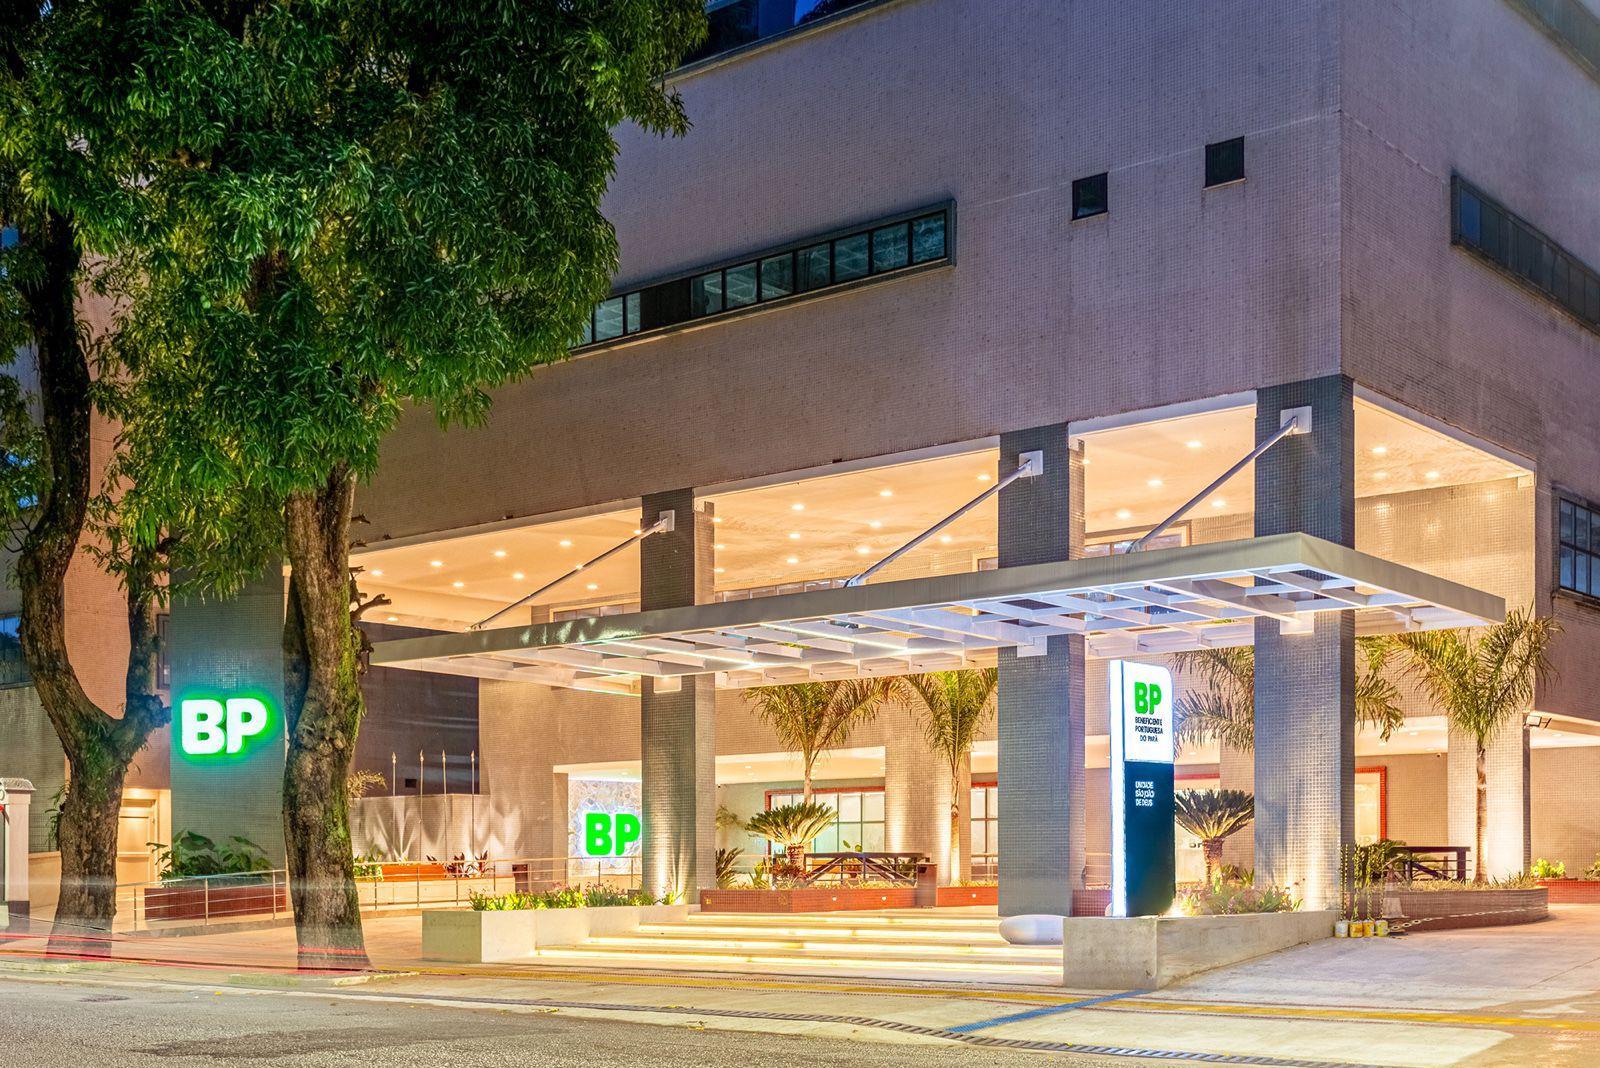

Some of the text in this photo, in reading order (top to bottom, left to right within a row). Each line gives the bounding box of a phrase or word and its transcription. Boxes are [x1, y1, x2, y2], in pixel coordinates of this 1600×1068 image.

[1134, 682, 1162, 715] BP
[181, 698, 267, 754] BP
[1135, 716, 1163, 726] BENEFICENTE
[1135, 725, 1164, 735] PORTUGUESA
[586, 813, 641, 856] BP
